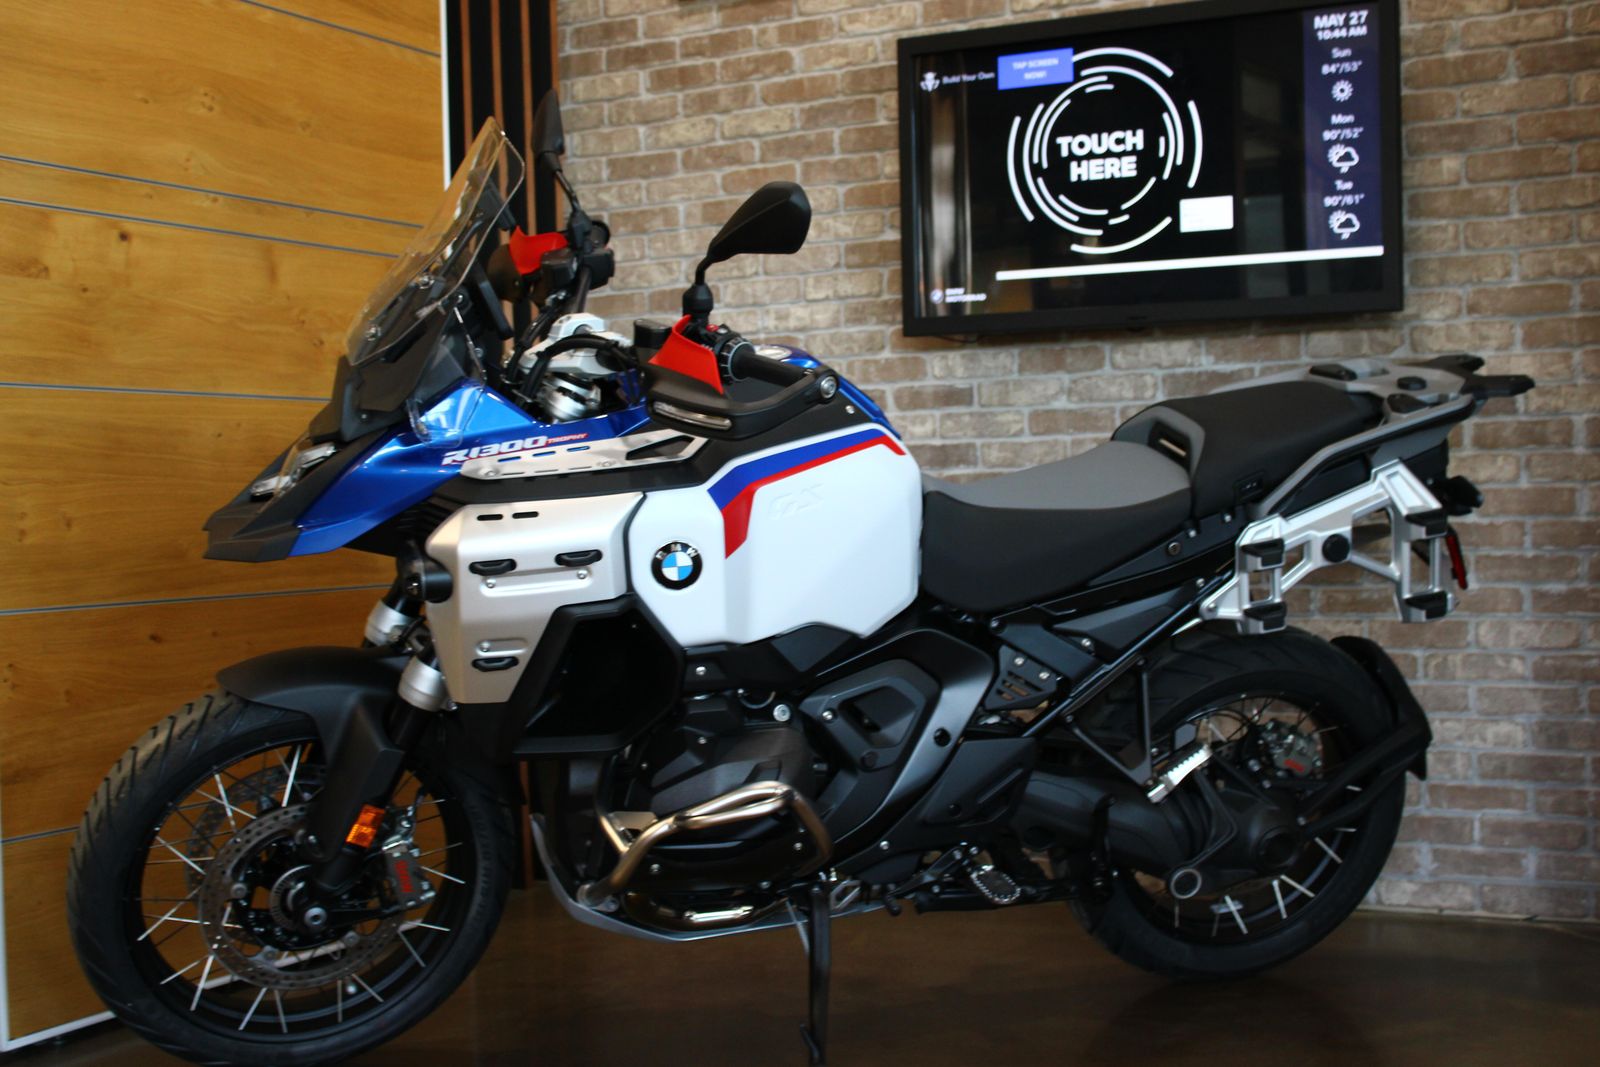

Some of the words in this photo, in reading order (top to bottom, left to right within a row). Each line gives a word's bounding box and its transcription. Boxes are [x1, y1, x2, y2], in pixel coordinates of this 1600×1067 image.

[1313, 12, 1346, 29] MAY
[1349, 10, 1368, 25] 27
[1348, 25, 1367, 37] AM
[1331, 47, 1352, 59] Sun
[1012, 60, 1028, 70] TAP
[1029, 57, 1059, 67] SCREEN
[1330, 114, 1355, 125] Mon
[1056, 128, 1144, 158] TOUCH
[1069, 155, 1138, 183] HERE
[1334, 179, 1354, 191] Tue
[547, 433, 589, 444] TROPHY
[655, 543, 699, 560] BMW
